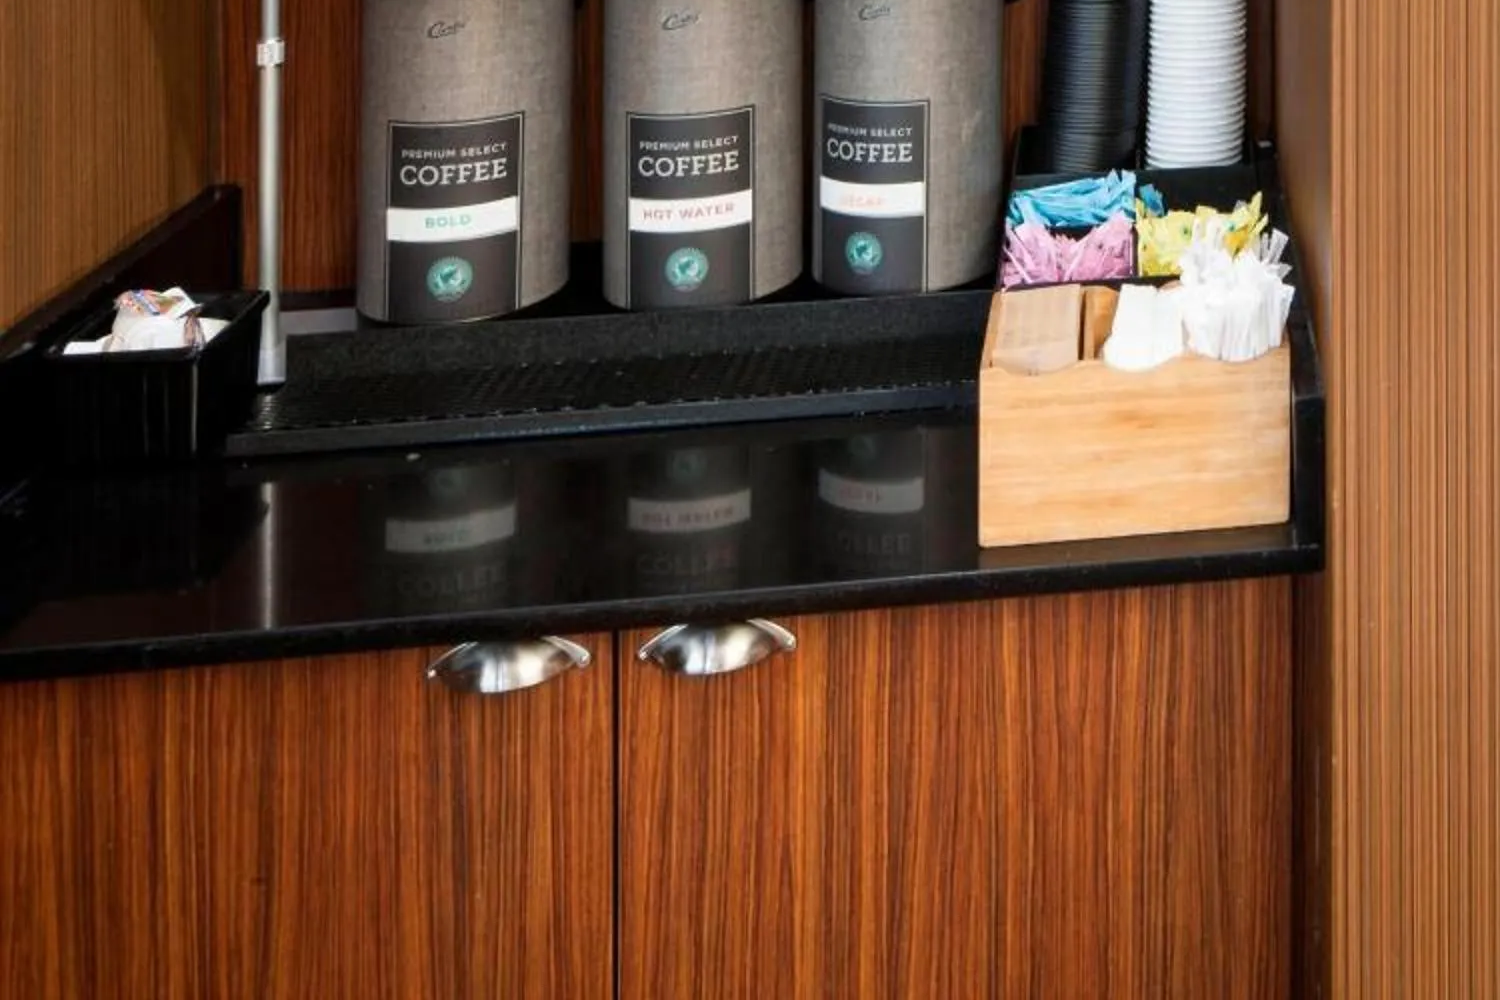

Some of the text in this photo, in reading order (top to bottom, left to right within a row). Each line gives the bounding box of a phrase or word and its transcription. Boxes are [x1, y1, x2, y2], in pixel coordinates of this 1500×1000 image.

[870, 127, 913, 138] SELECT
[401, 141, 508, 160] PREMIUM SELECT
[639, 135, 739, 151] PREMIUM SELECT
[827, 137, 913, 164] COFFEE
[400, 157, 508, 186] COFFEE
[638, 151, 740, 177] COFFEE
[642, 202, 736, 221] HOT WATER
[425, 214, 472, 229] BOLD
